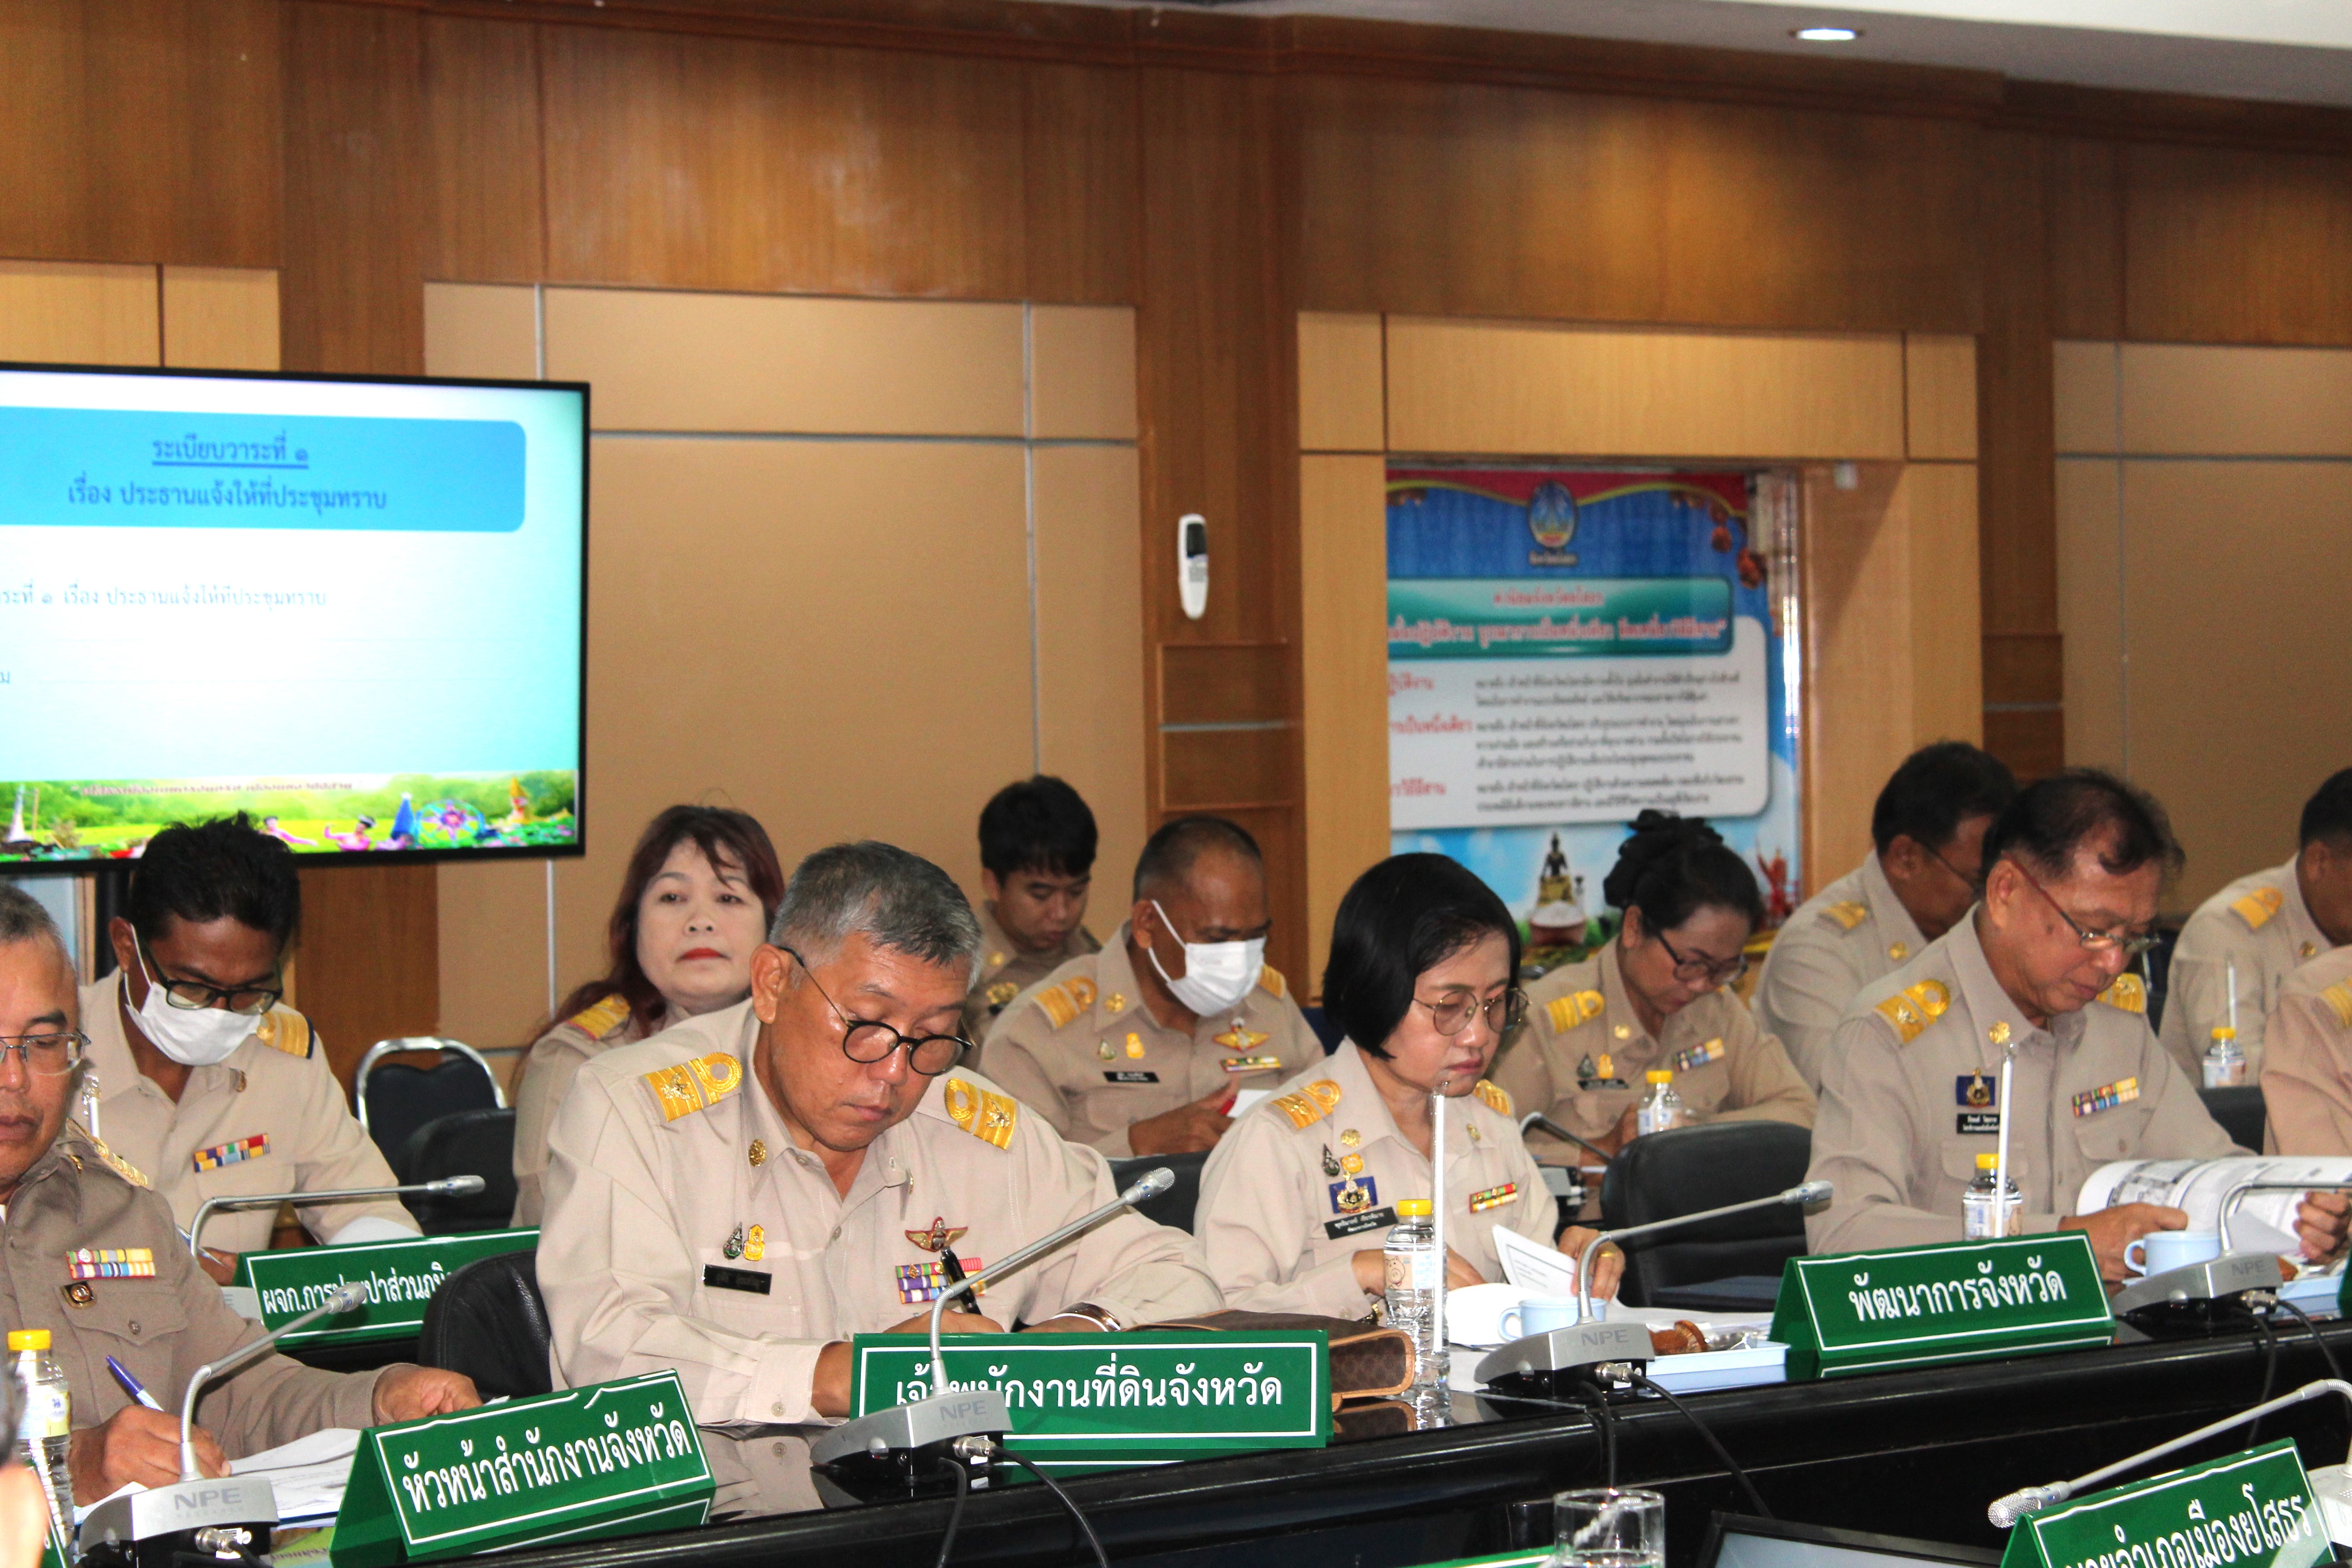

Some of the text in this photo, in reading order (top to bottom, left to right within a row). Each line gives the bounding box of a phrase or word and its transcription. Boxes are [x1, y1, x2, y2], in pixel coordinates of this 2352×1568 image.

[152, 429, 309, 461] ระเบียบวาระที่ ๑
[69, 471, 387, 516] เรื่อง ประธานแจ้งให้ที่ประชุมทราบ
[64, 578, 99, 605] เรื่อง
[1848, 1254, 2068, 1323] พัฒนาการจังหวัด
[1581, 1329, 1629, 1346] NPE
[940, 1400, 987, 1421] NPE
[402, 1401, 692, 1513] หัวหน้าสำนักงานจังหวัด
[174, 1486, 242, 1510] NPE
